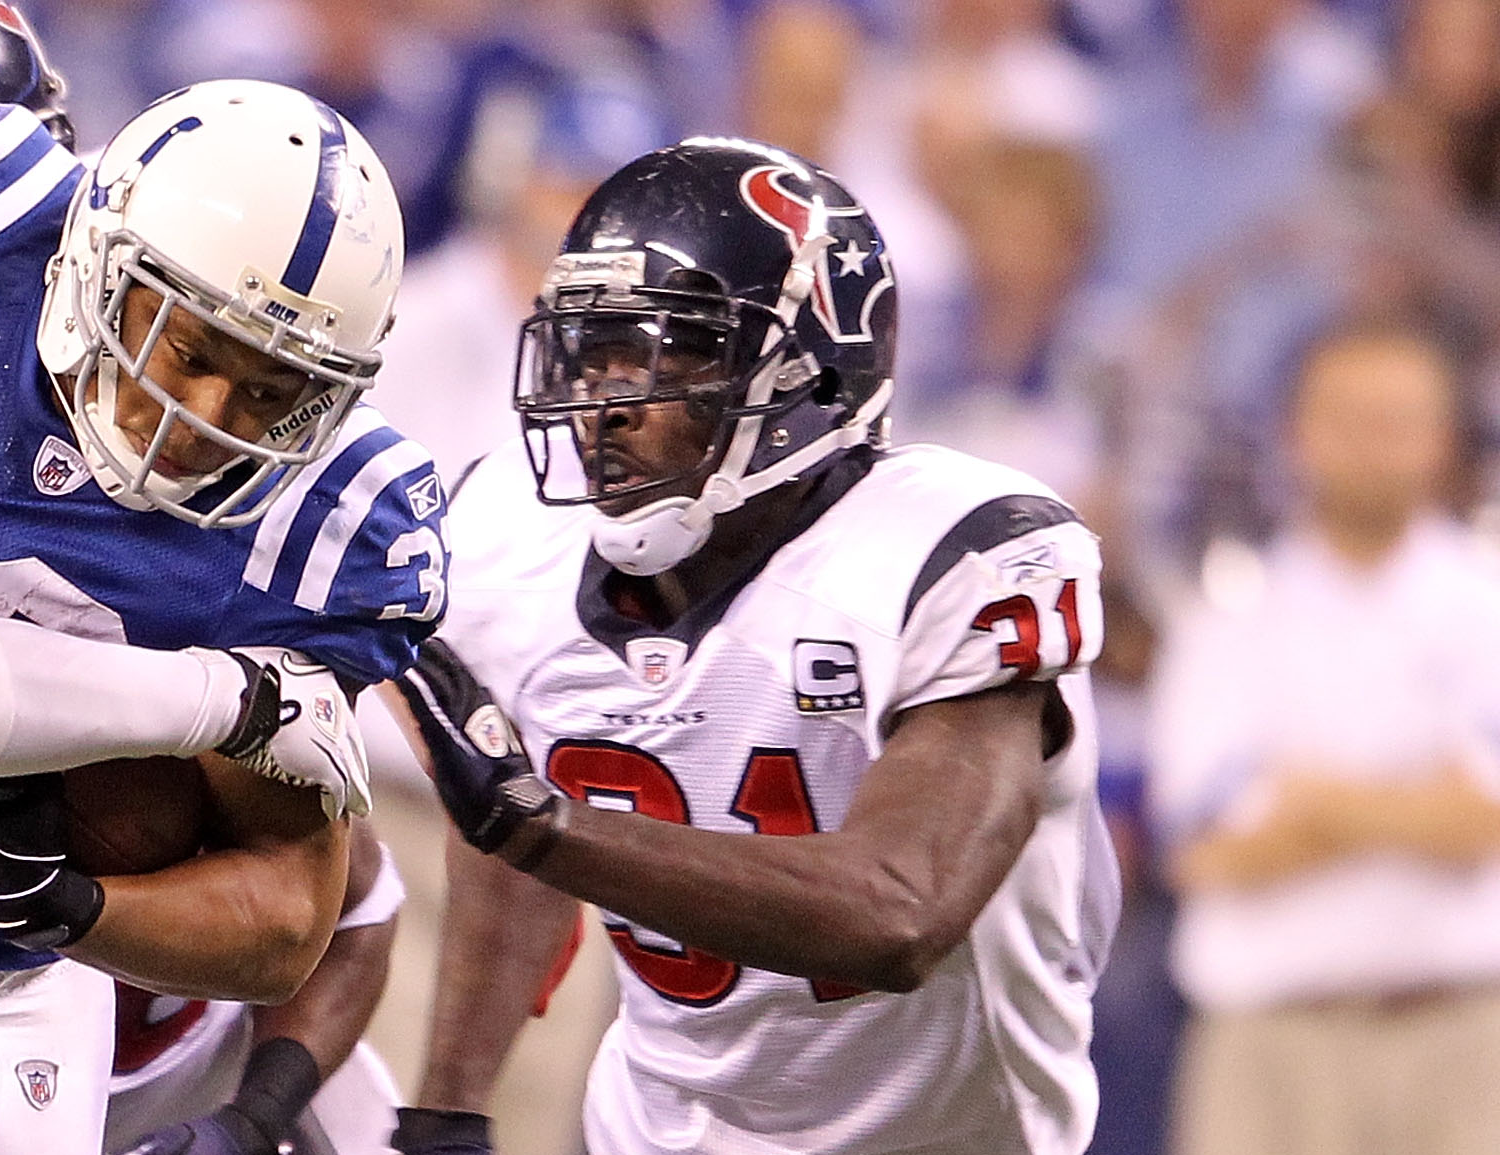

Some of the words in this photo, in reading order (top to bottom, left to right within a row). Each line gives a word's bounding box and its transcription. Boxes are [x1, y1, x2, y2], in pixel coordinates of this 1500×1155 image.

[267, 393, 335, 442] Riddell
[41, 465, 66, 489] NFL
[377, 515, 451, 622] 3
[970, 577, 1082, 679] 31
